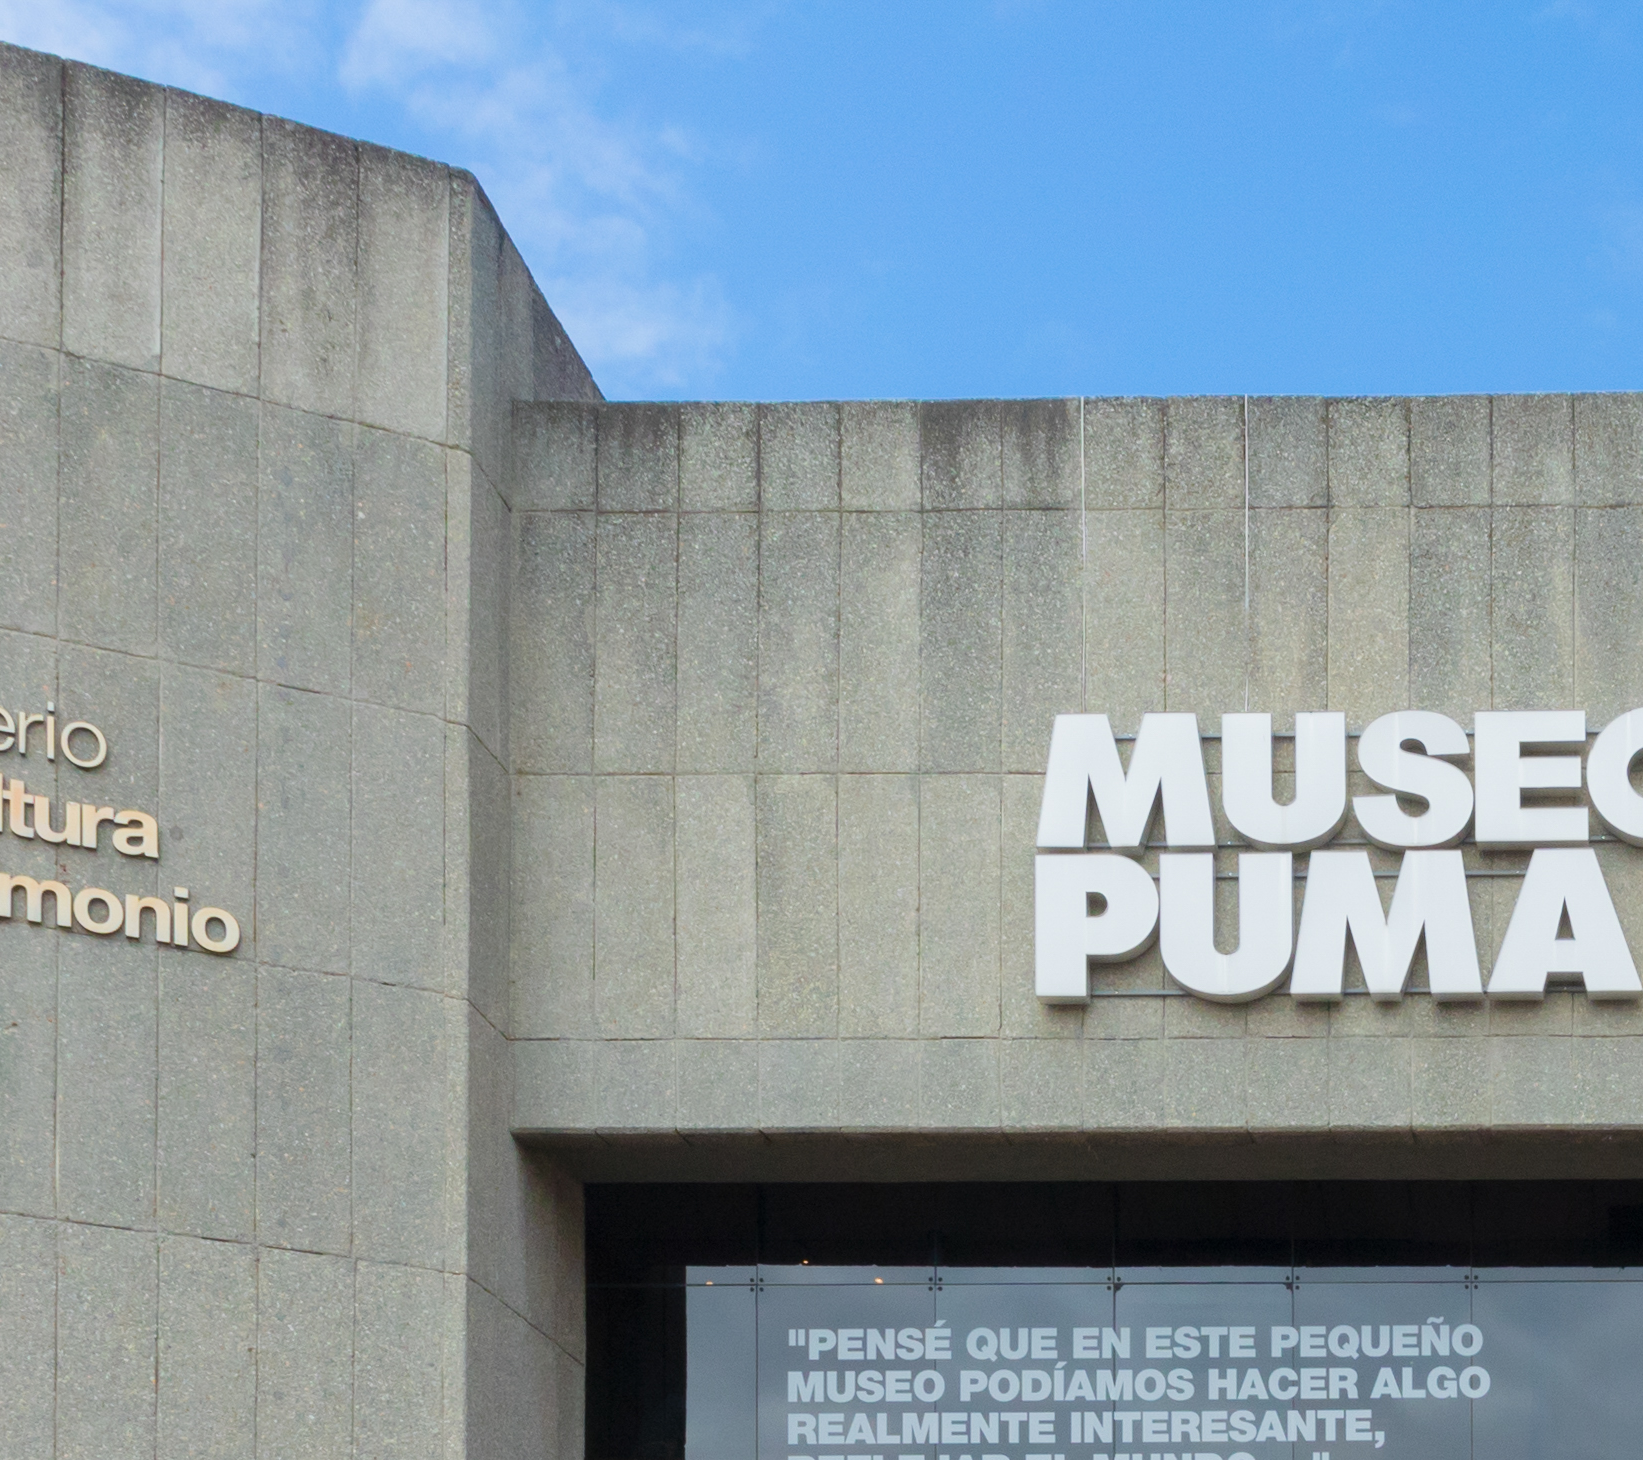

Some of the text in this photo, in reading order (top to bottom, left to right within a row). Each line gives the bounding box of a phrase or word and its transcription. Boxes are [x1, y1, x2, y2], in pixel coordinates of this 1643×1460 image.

[787, 1316, 1484, 1362] "PENSÉ QUE EN ESTE PEQUEÑO
[787, 1361, 1491, 1404] MUSEO PODÍAMOS HACER ALGO
[787, 1408, 1386, 1449] REALMENTE INTERESANTE,
